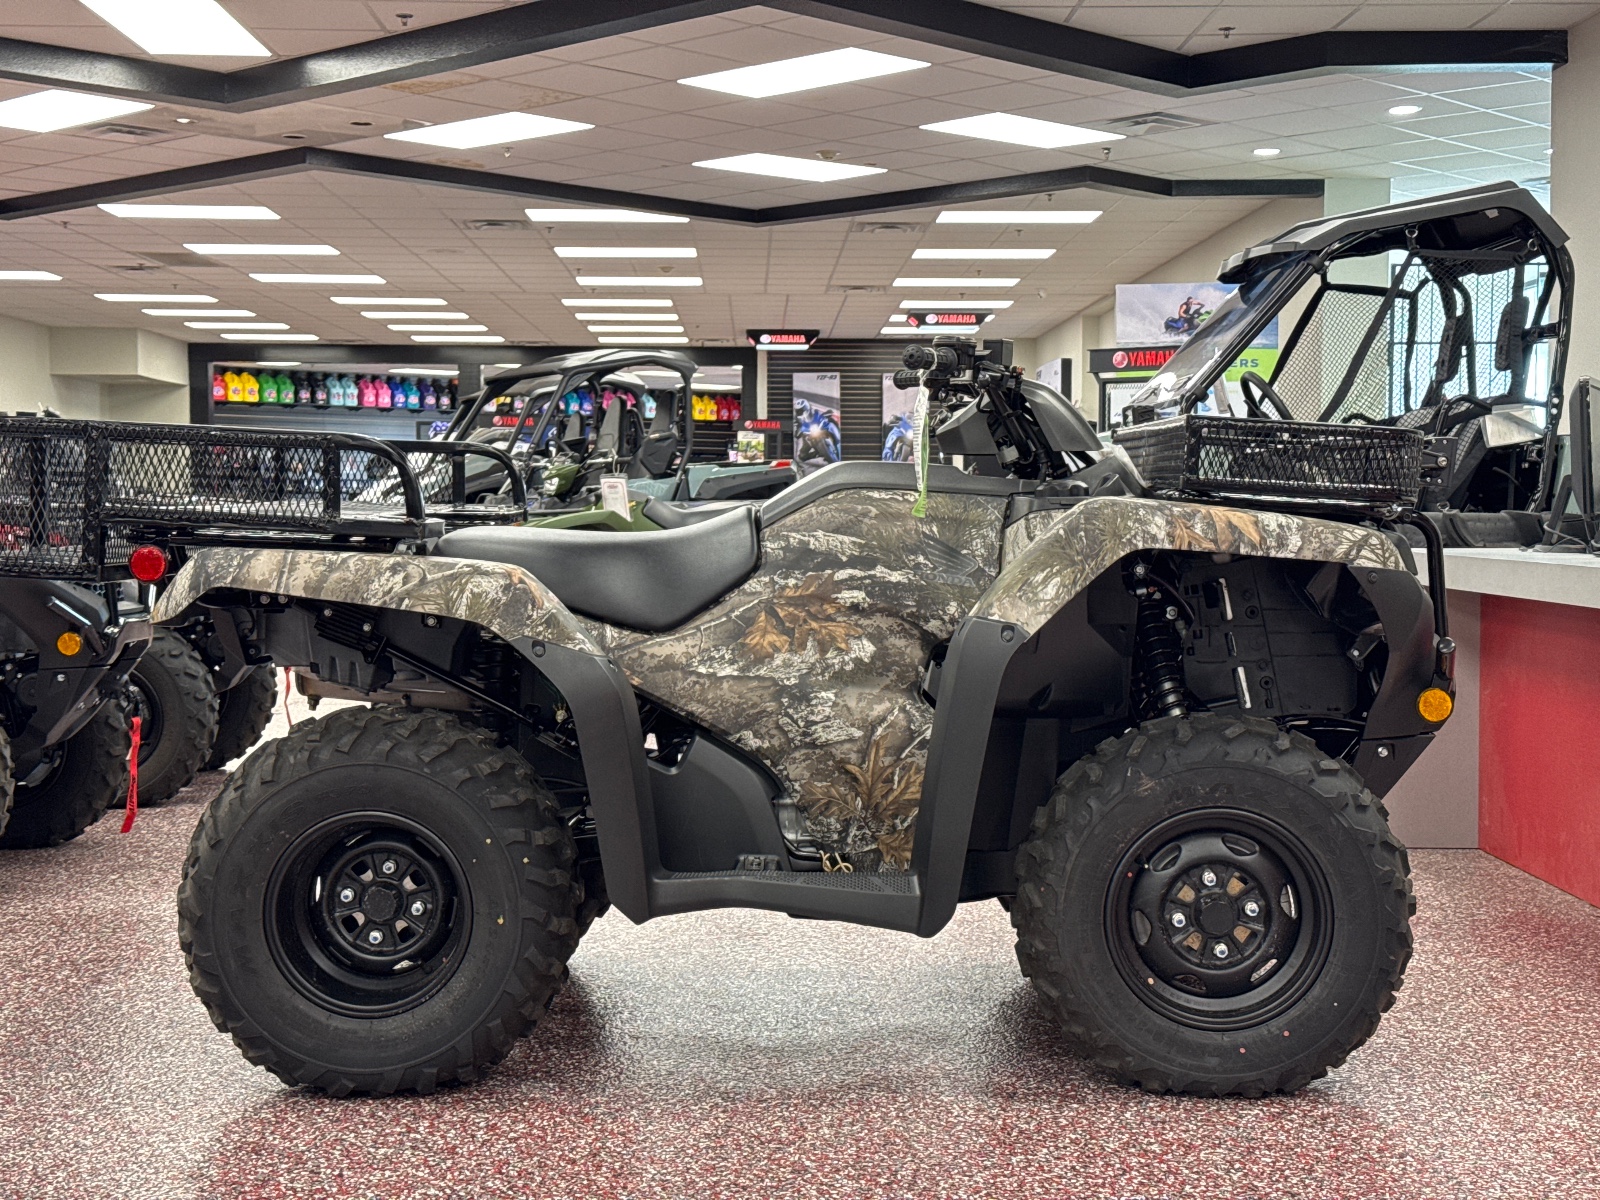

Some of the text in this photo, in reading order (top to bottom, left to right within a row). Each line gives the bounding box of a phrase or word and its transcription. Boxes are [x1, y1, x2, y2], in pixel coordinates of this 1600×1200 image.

[938, 314, 976, 323] YAMAHA
[771, 335, 806, 343] YAMAHA
[1129, 350, 1174, 366] YAMAH
[1230, 359, 1259, 367] ERS
[502, 416, 534, 426] YAMHA
[753, 421, 781, 429] YAMAHA
